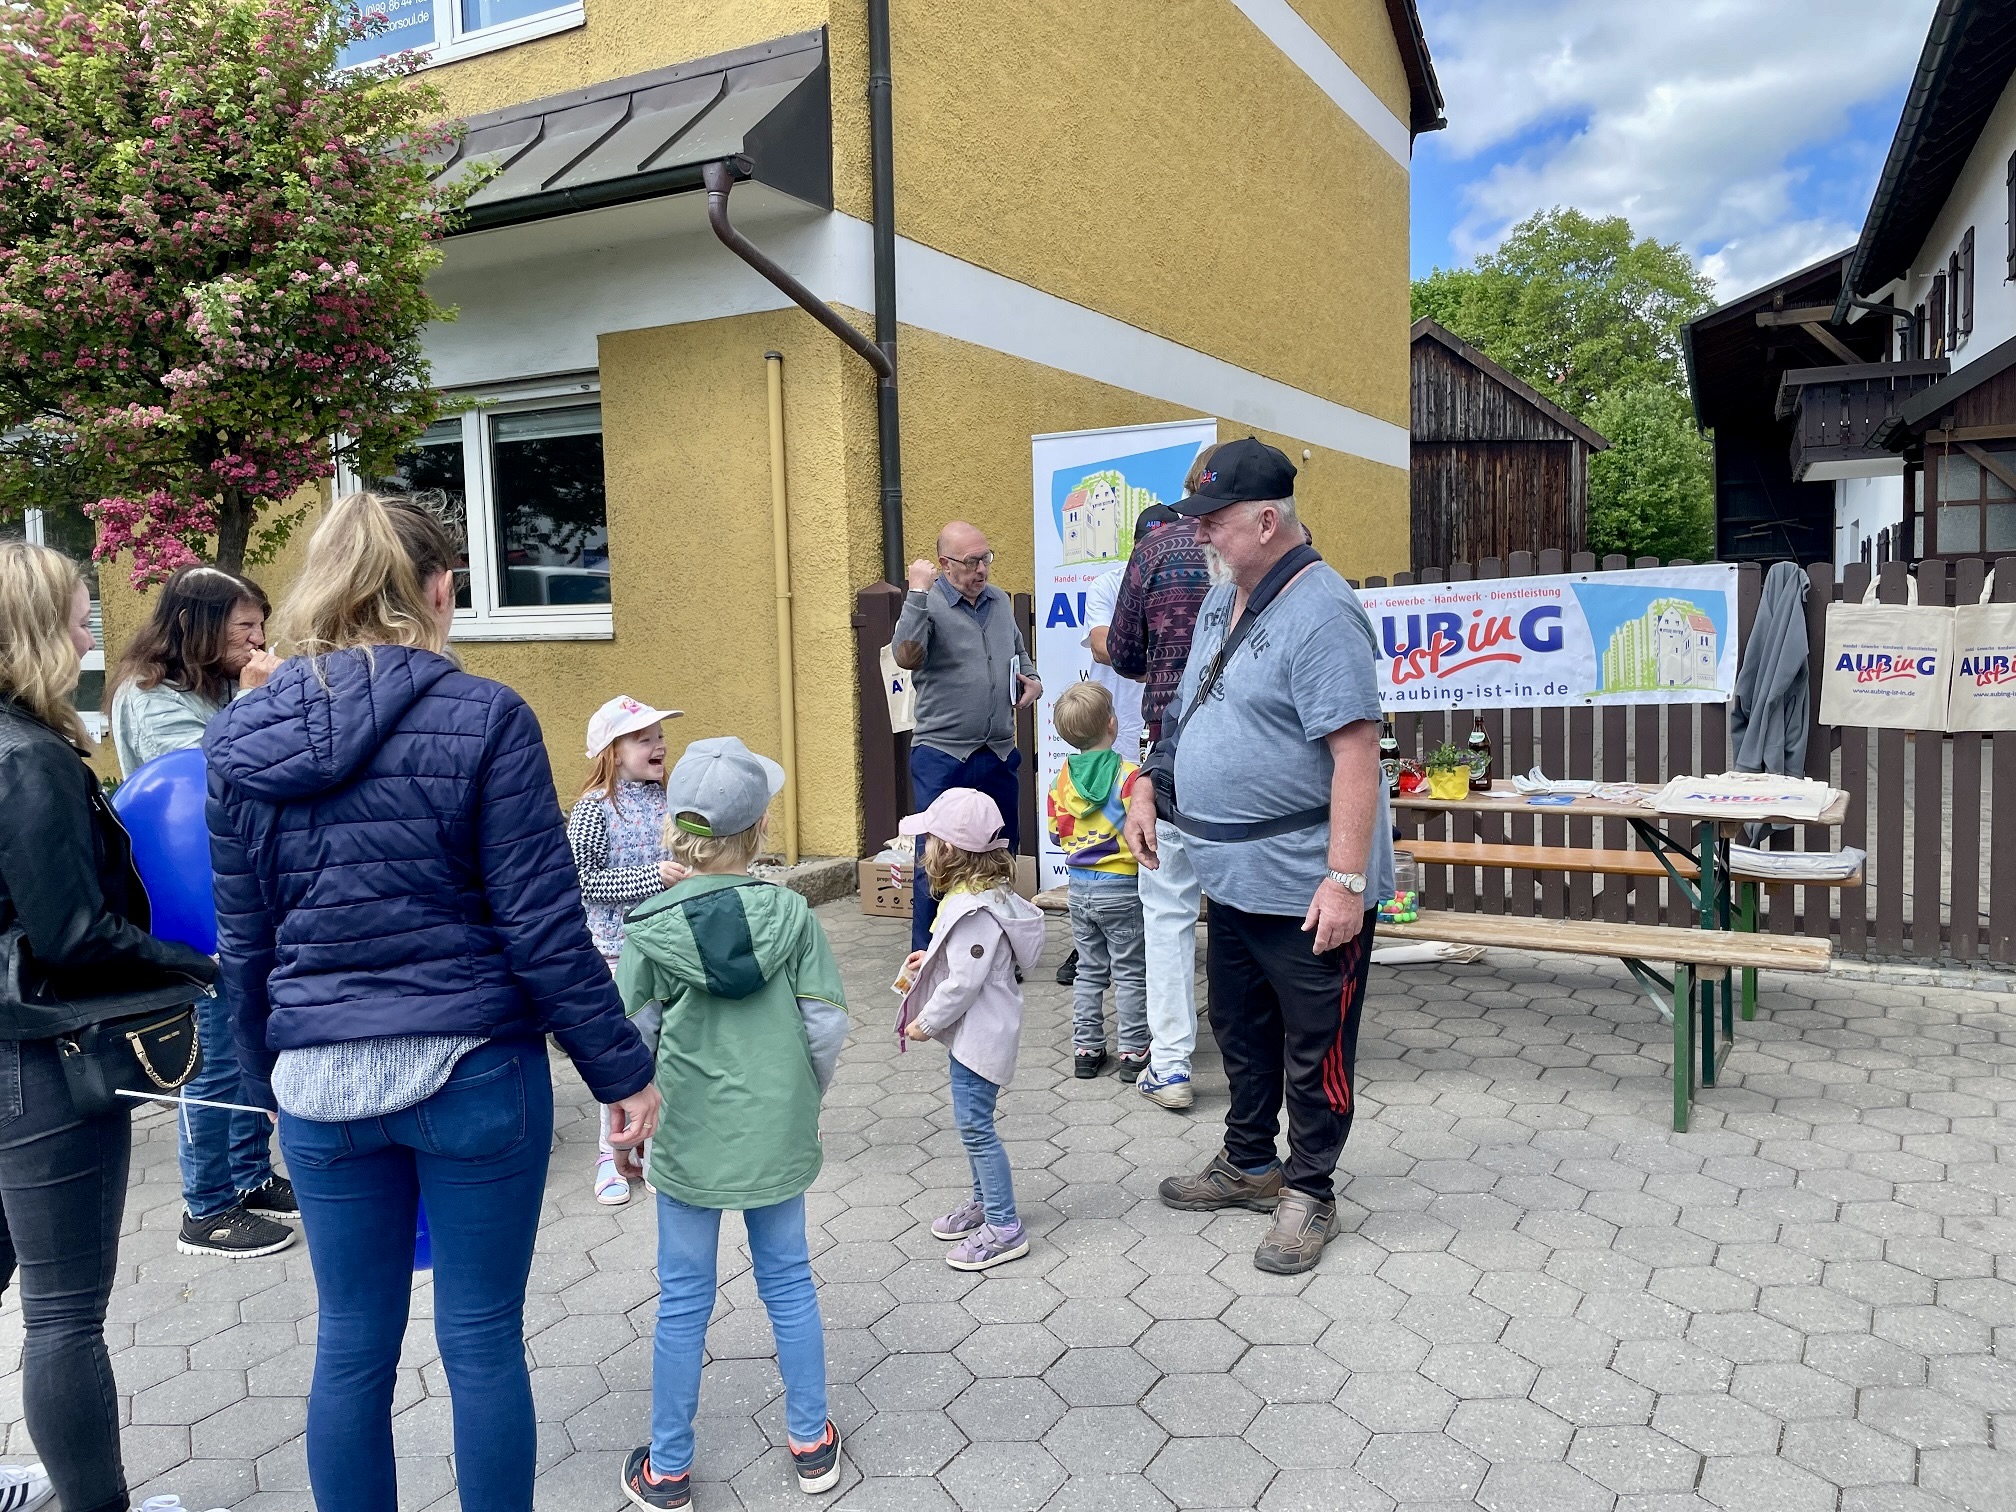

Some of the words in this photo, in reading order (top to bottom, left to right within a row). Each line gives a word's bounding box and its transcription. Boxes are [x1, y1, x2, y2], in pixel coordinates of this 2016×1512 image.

[1054, 574, 1077, 583] Handel
[1363, 599, 1377, 609] del
[1385, 597, 1425, 607] Gewerbe
[1434, 593, 1482, 604] Handwerk
[1490, 588, 1561, 600] Dienstleistung
[1853, 687, 1916, 697] www.aubing-ist-in.de
